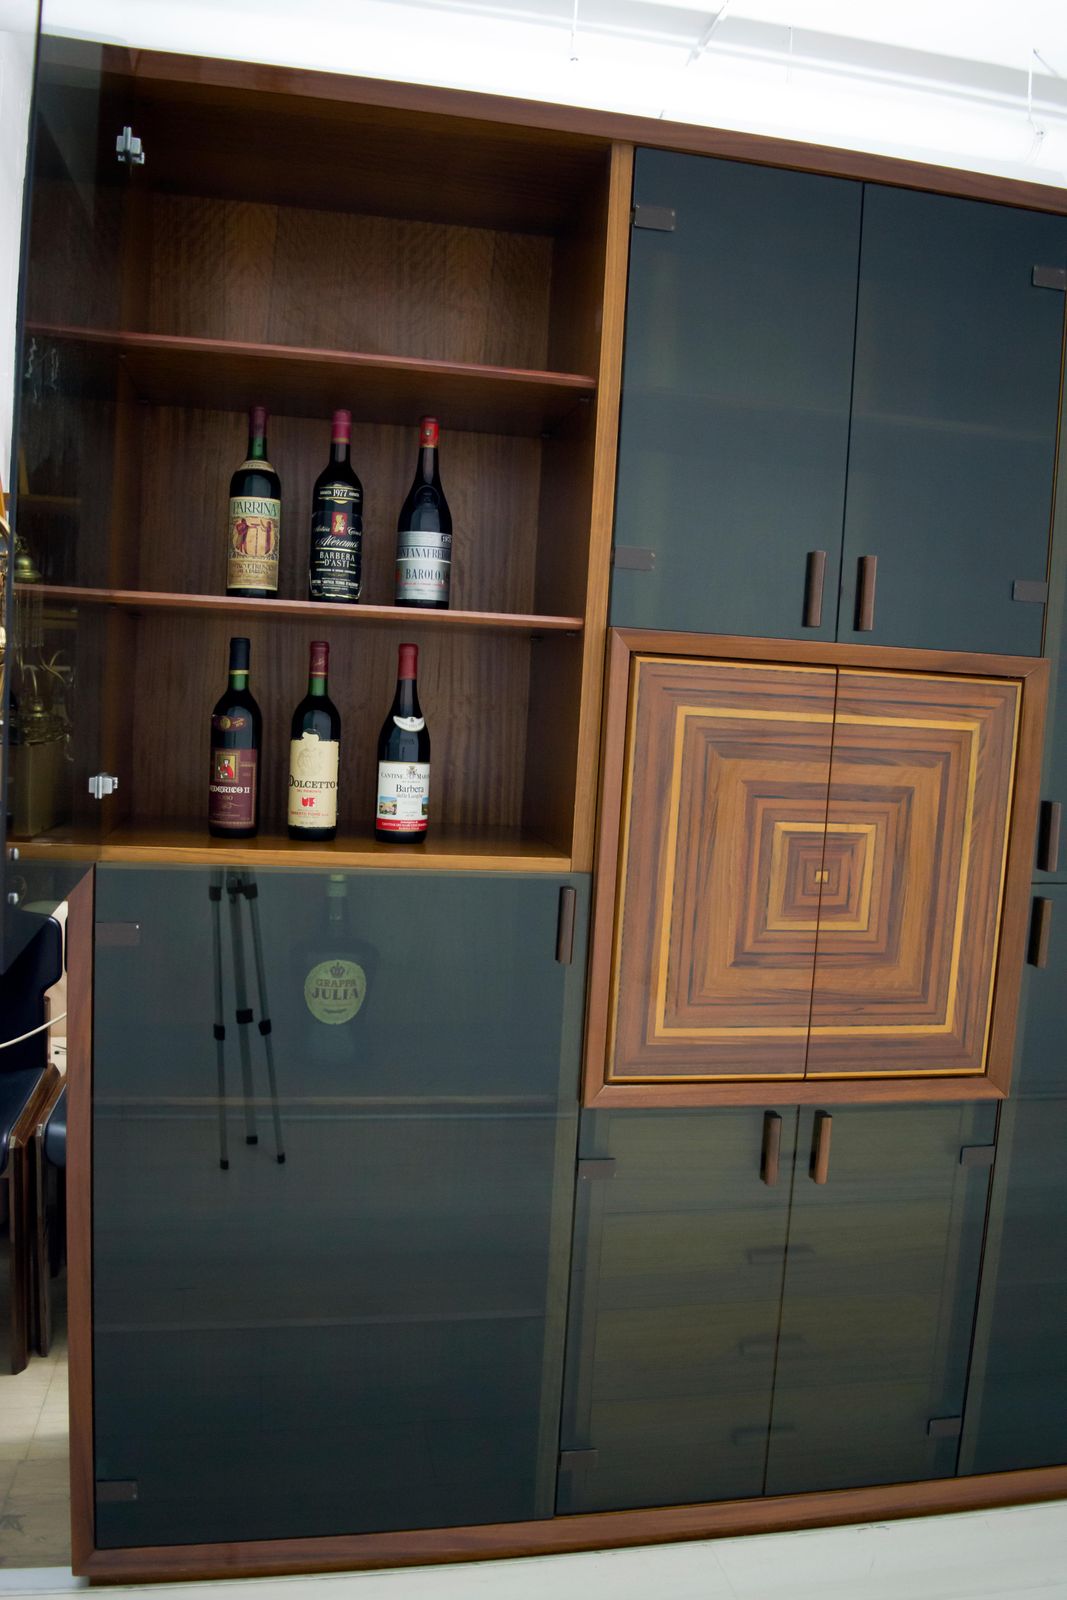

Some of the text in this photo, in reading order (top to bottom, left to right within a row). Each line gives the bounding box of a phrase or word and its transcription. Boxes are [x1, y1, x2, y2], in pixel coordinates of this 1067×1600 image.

[333, 489, 349, 497] 1977
[233, 501, 277, 516] PARRINA
[320, 551, 355, 562] BARBERA
[324, 559, 350, 568] D'ASTI
[405, 568, 441, 581] BAROLO
[289, 775, 336, 789] DOLCETTO
[396, 783, 424, 793] Barbera
[315, 979, 356, 988] GRAPPA
[311, 988, 359, 1000] JULIA
